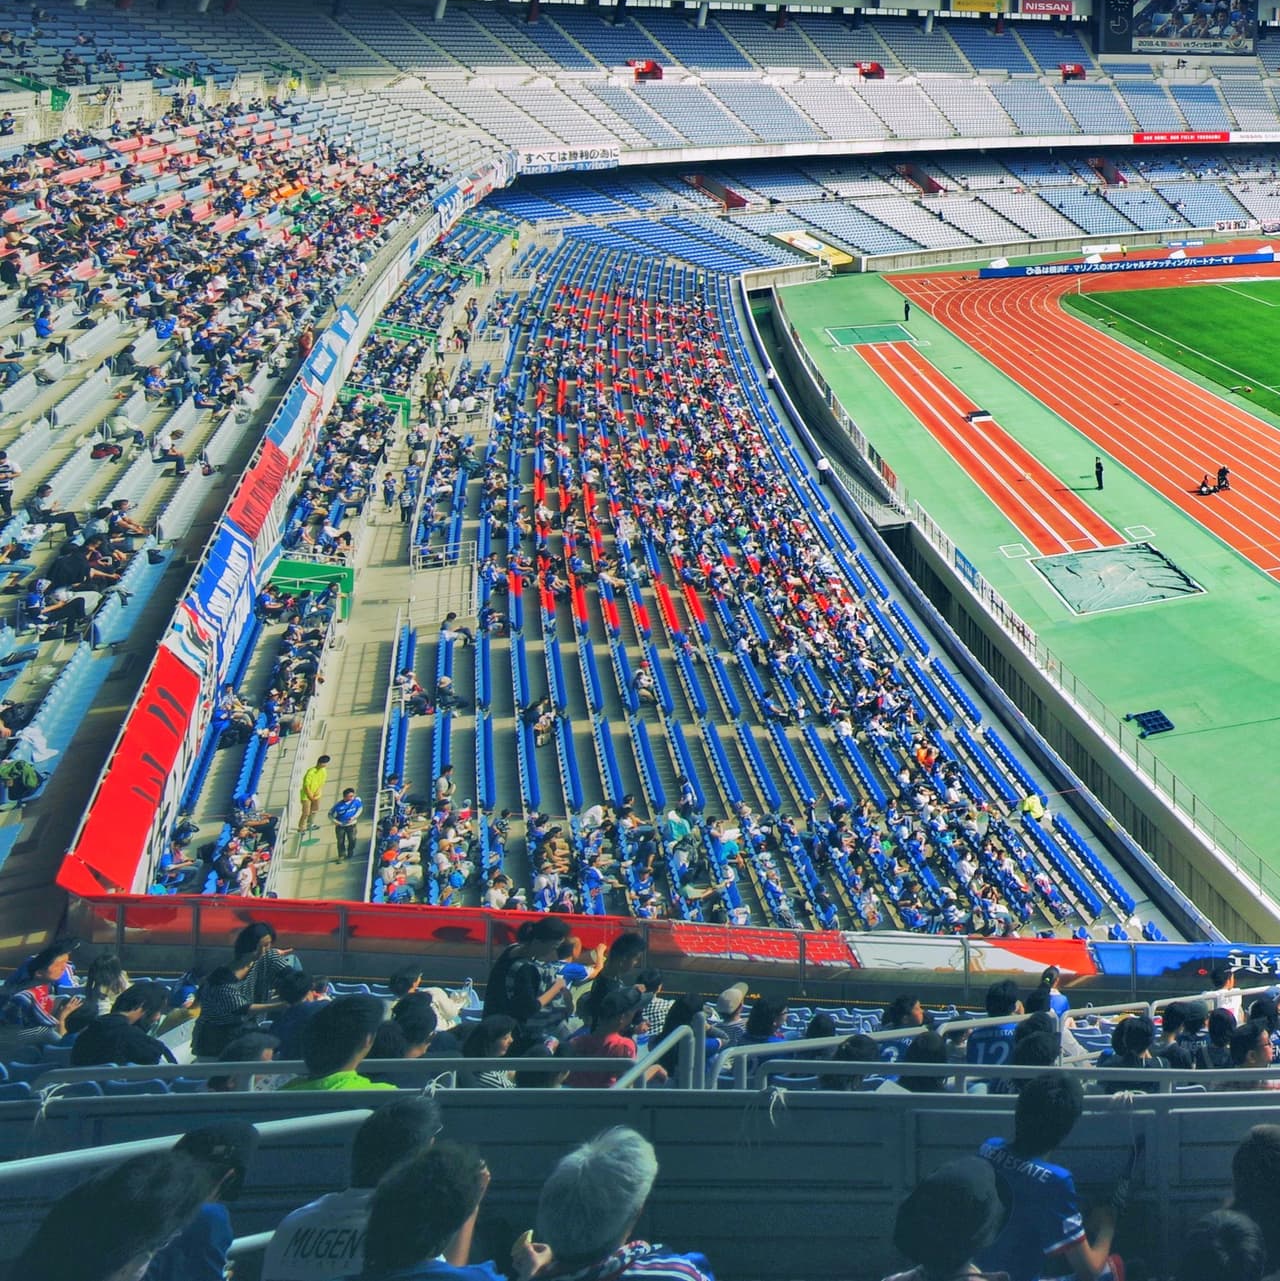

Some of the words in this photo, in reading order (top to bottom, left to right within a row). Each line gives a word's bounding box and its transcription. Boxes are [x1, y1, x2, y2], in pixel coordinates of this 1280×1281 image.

[1025, 2, 1070, 11] NISSAN
[524, 148, 619, 164] すべては勝利の為に
[283, 1227, 365, 1259] MUGEN
